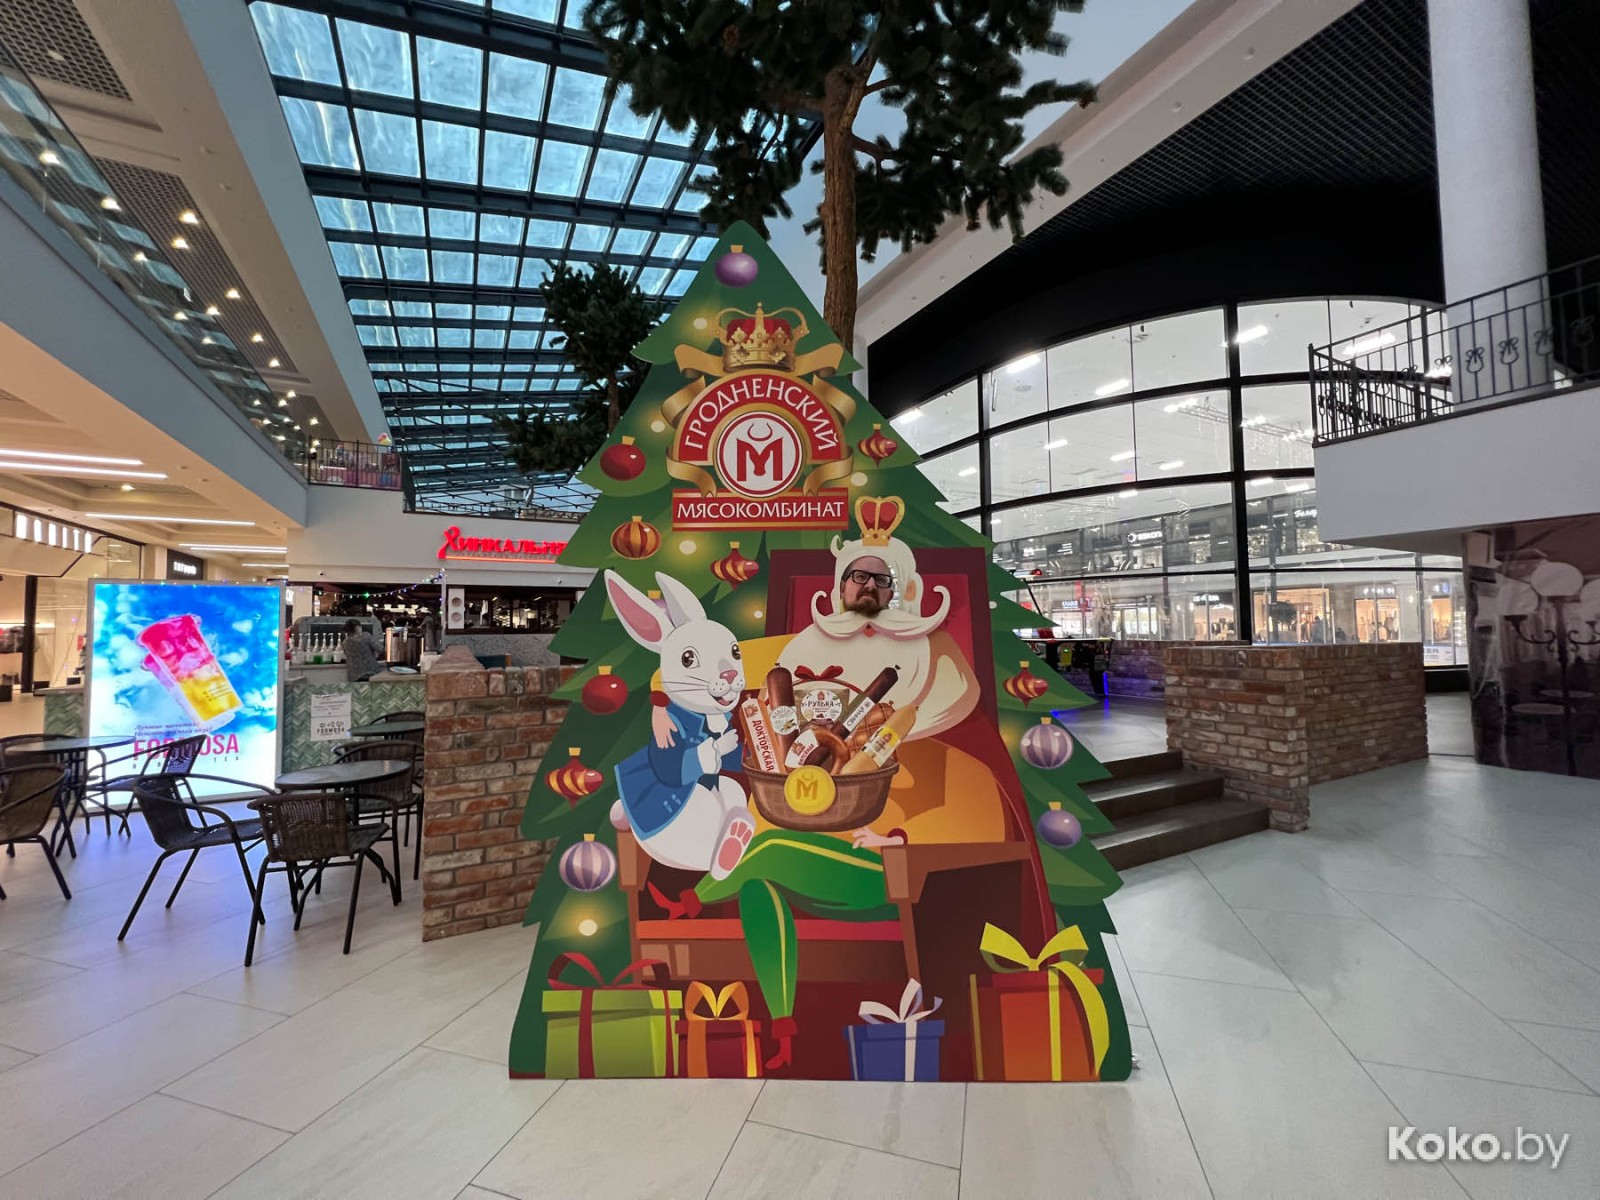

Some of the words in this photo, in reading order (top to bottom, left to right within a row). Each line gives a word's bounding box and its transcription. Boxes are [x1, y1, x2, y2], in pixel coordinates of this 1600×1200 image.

[684, 377, 839, 451] ГРОДНЕНСКИЙ
[677, 501, 844, 519] МЯСОКОМБИНАТ
[807, 700, 834, 708] РУЛЬКА
[752, 719, 775, 772] ДОКТОРСКАЯ
